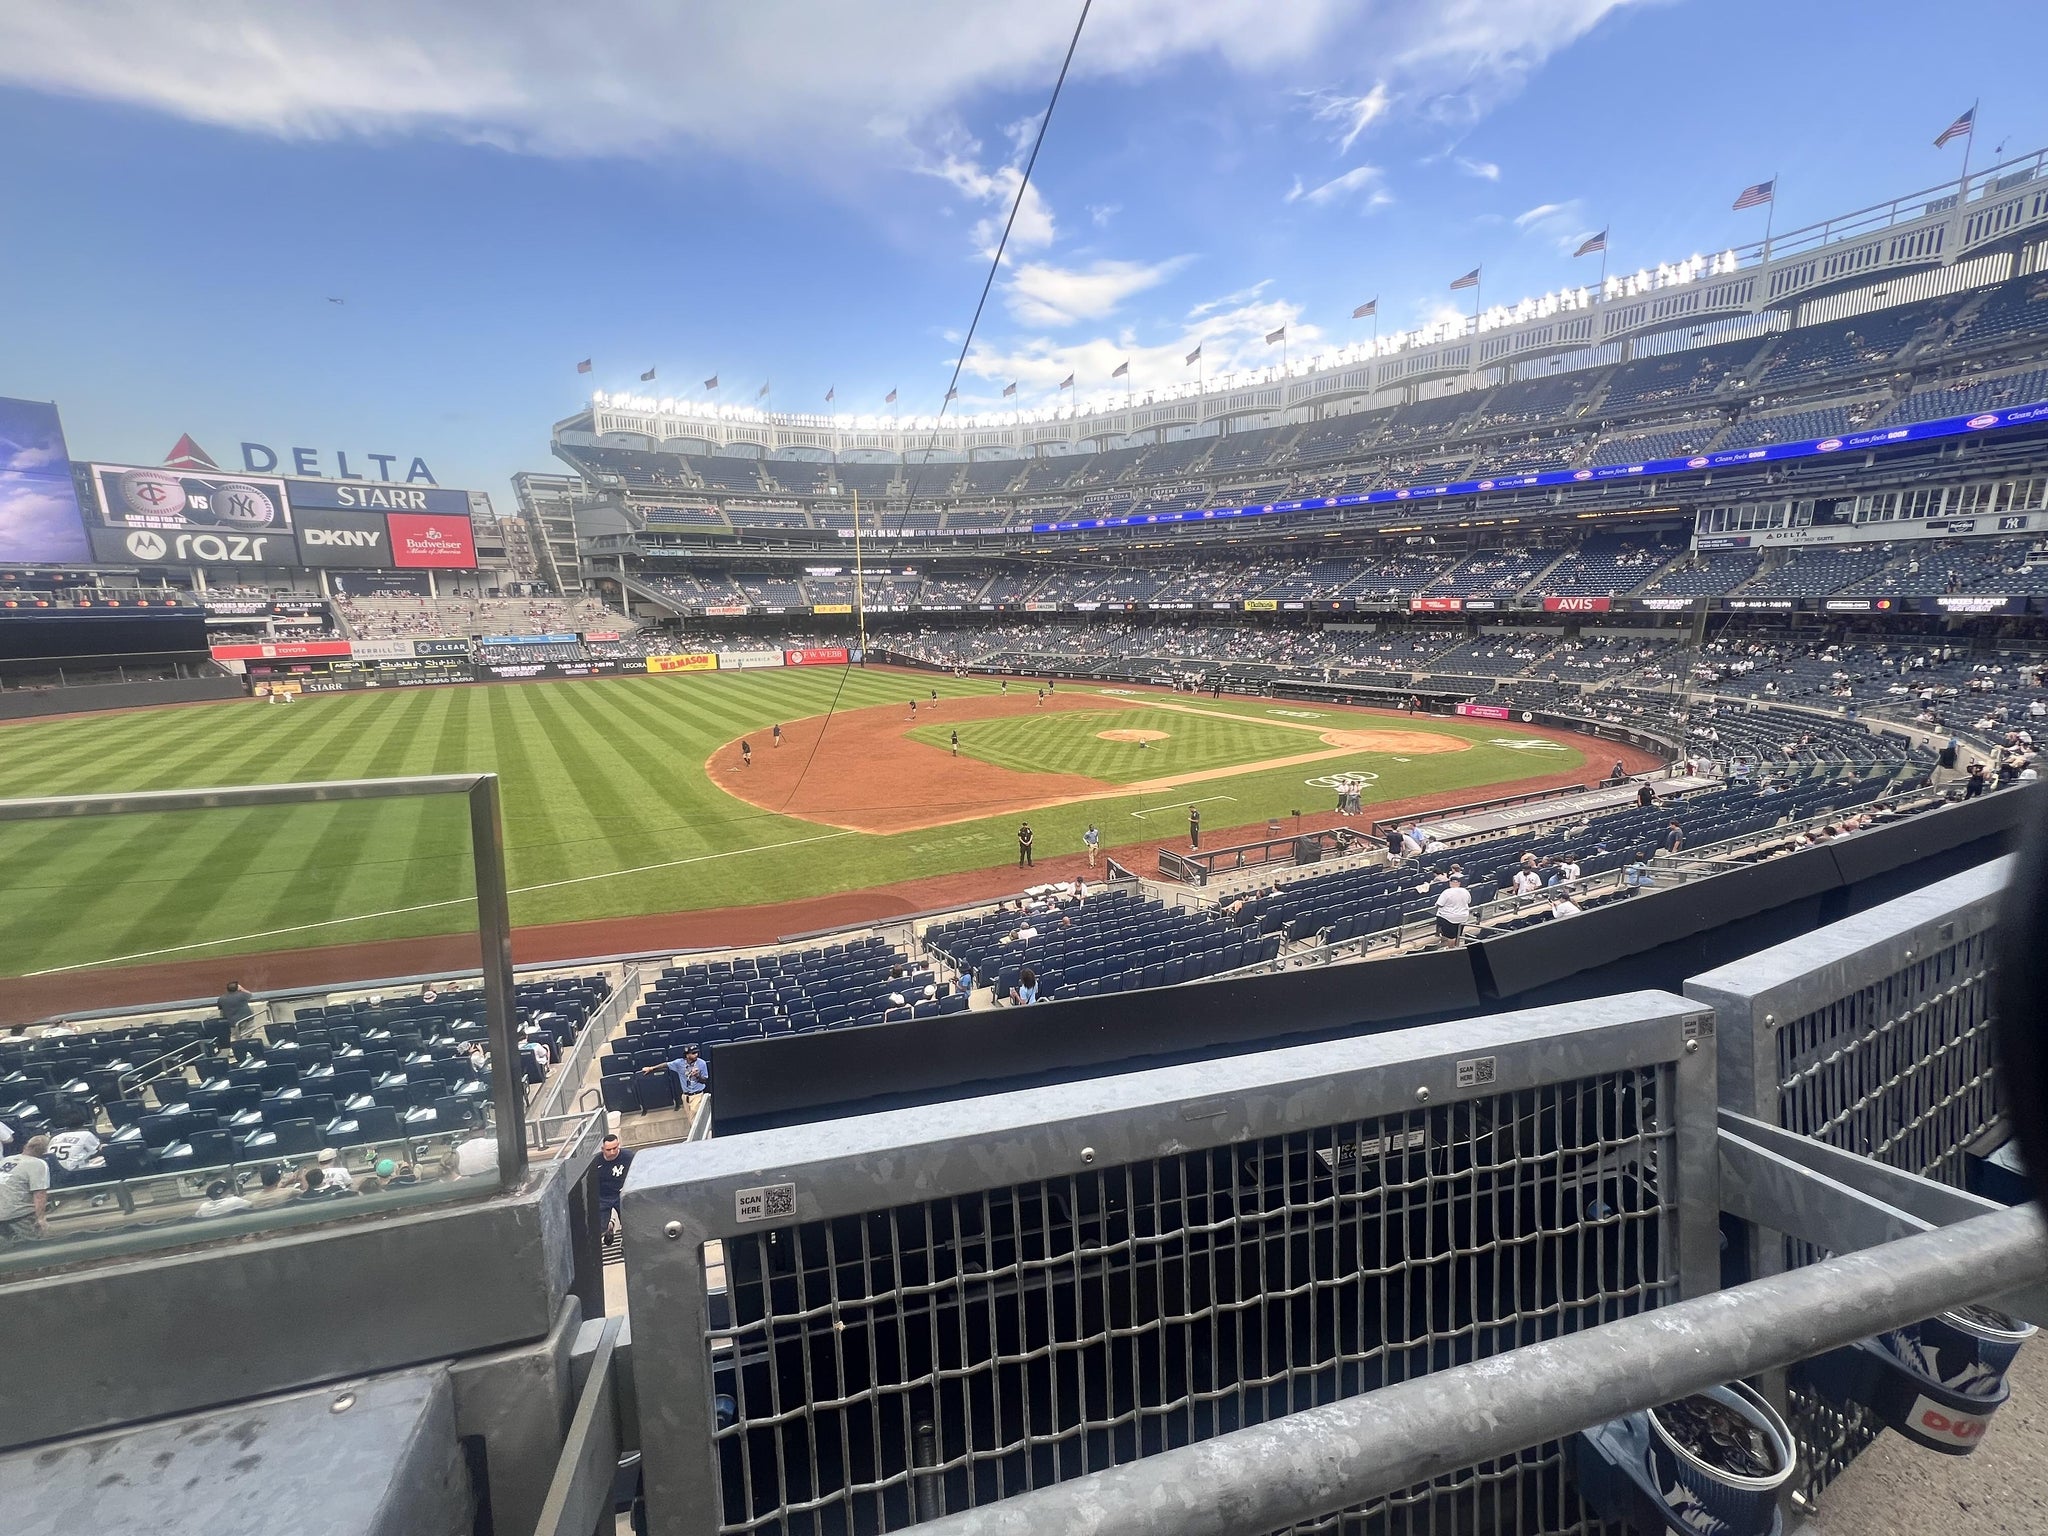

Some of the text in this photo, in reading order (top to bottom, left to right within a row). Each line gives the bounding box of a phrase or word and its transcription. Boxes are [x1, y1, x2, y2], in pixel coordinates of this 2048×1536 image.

[2008, 411, 2031, 420] Clean
[240, 442, 438, 486] DELTA
[188, 495, 208, 510] VS
[336, 486, 427, 510] STARR
[303, 528, 380, 547] DKNY
[901, 529, 914, 537] NOW
[176, 534, 267, 561] razr
[406, 538, 462, 549] Budweiser
[1558, 599, 1592, 610] AVIS
[660, 656, 708, 670] W.B.MASON
[310, 683, 342, 691] STARR
[1459, 1074, 1473, 1082] HERE
[612, 1164, 625, 1177] NY
[740, 1195, 761, 1205] SCAN
[741, 1205, 761, 1215] HERE
